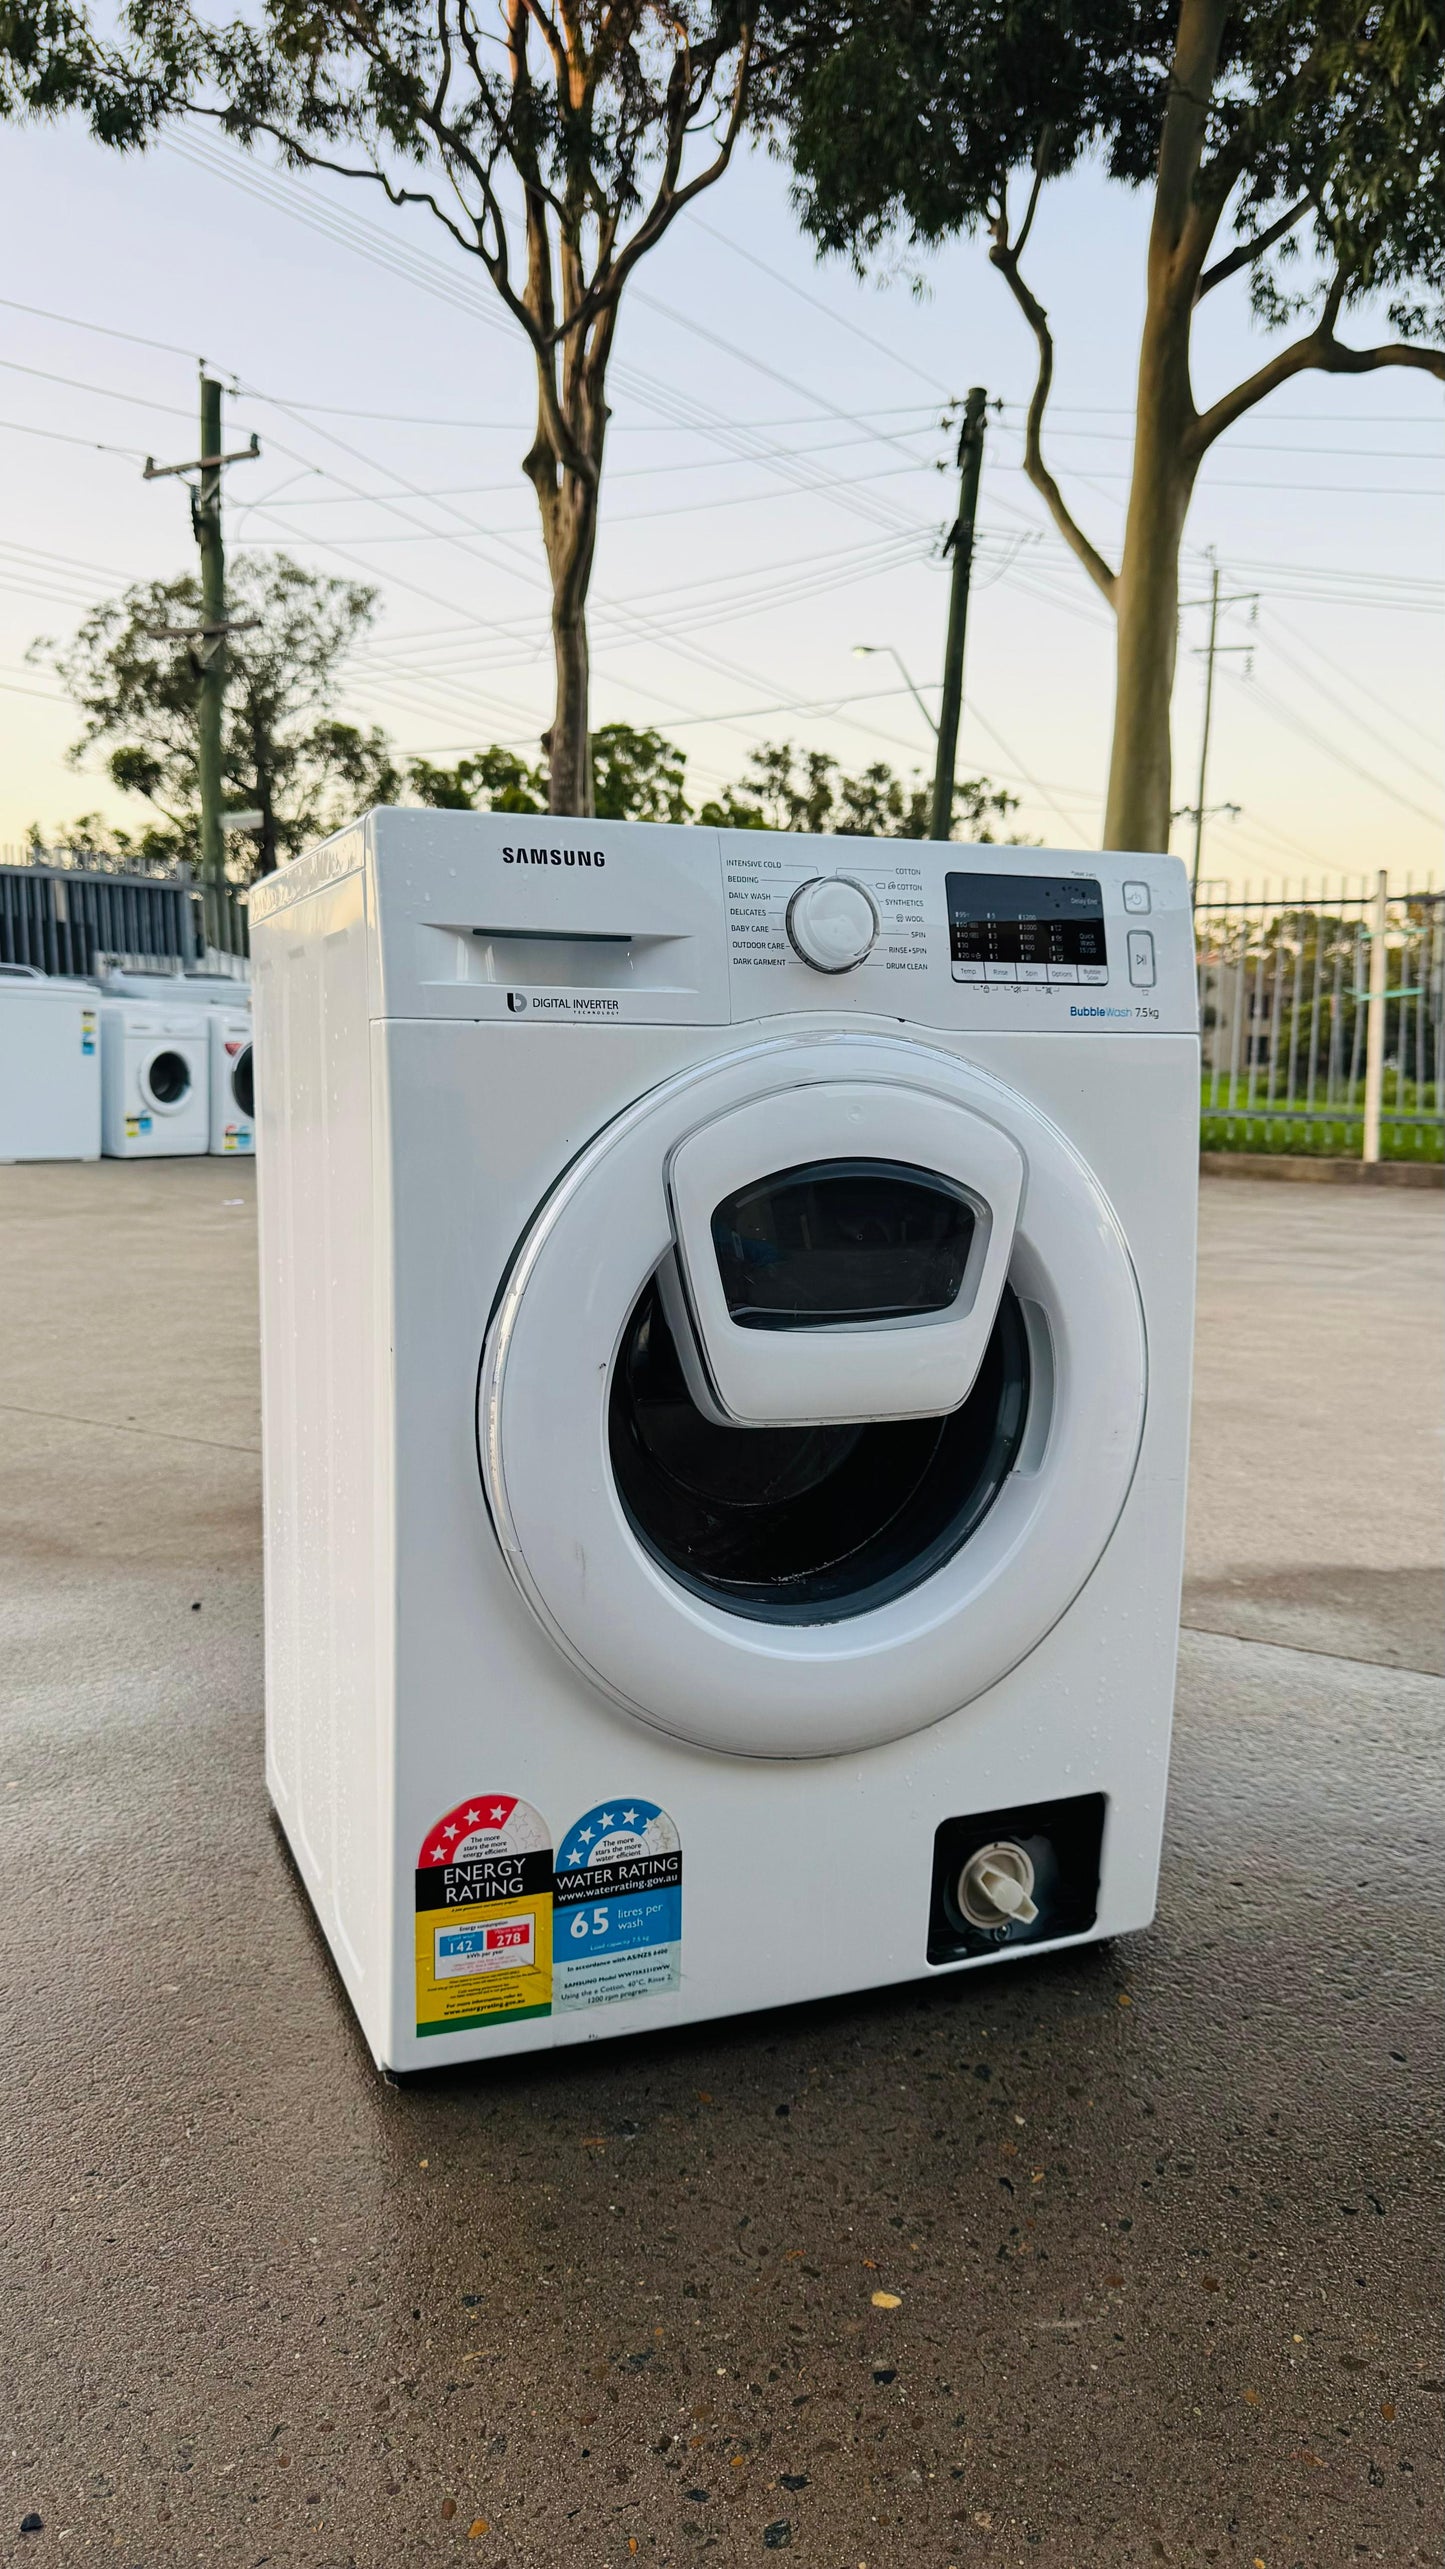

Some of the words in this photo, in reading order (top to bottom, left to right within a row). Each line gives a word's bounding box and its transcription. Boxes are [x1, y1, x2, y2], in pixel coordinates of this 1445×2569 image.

[502, 847, 605, 867] SAMSUNG
[533, 998, 571, 1008] DIGITAL
[574, 1000, 619, 1010] INVERTER
[444, 1858, 526, 1884] ENERGY
[557, 1869, 614, 1890] WATER
[619, 1858, 678, 1879] RATING
[446, 1878, 524, 1903] RATING
[558, 1874, 678, 1901] www.waterrating.gov.au
[618, 1908, 643, 1918] litres
[646, 1904, 663, 1916] per
[570, 1907, 609, 1938] 65
[618, 1918, 644, 1930] wash
[497, 1933, 521, 1946] 278
[450, 1940, 472, 1953] 142
[575, 1960, 611, 1970] accordance
[564, 1979, 597, 1989] SAMSUNG
[561, 1992, 579, 2000] Using
[620, 1988, 648, 1998] program
[444, 1999, 525, 2015] www.energyrating.gov.au
